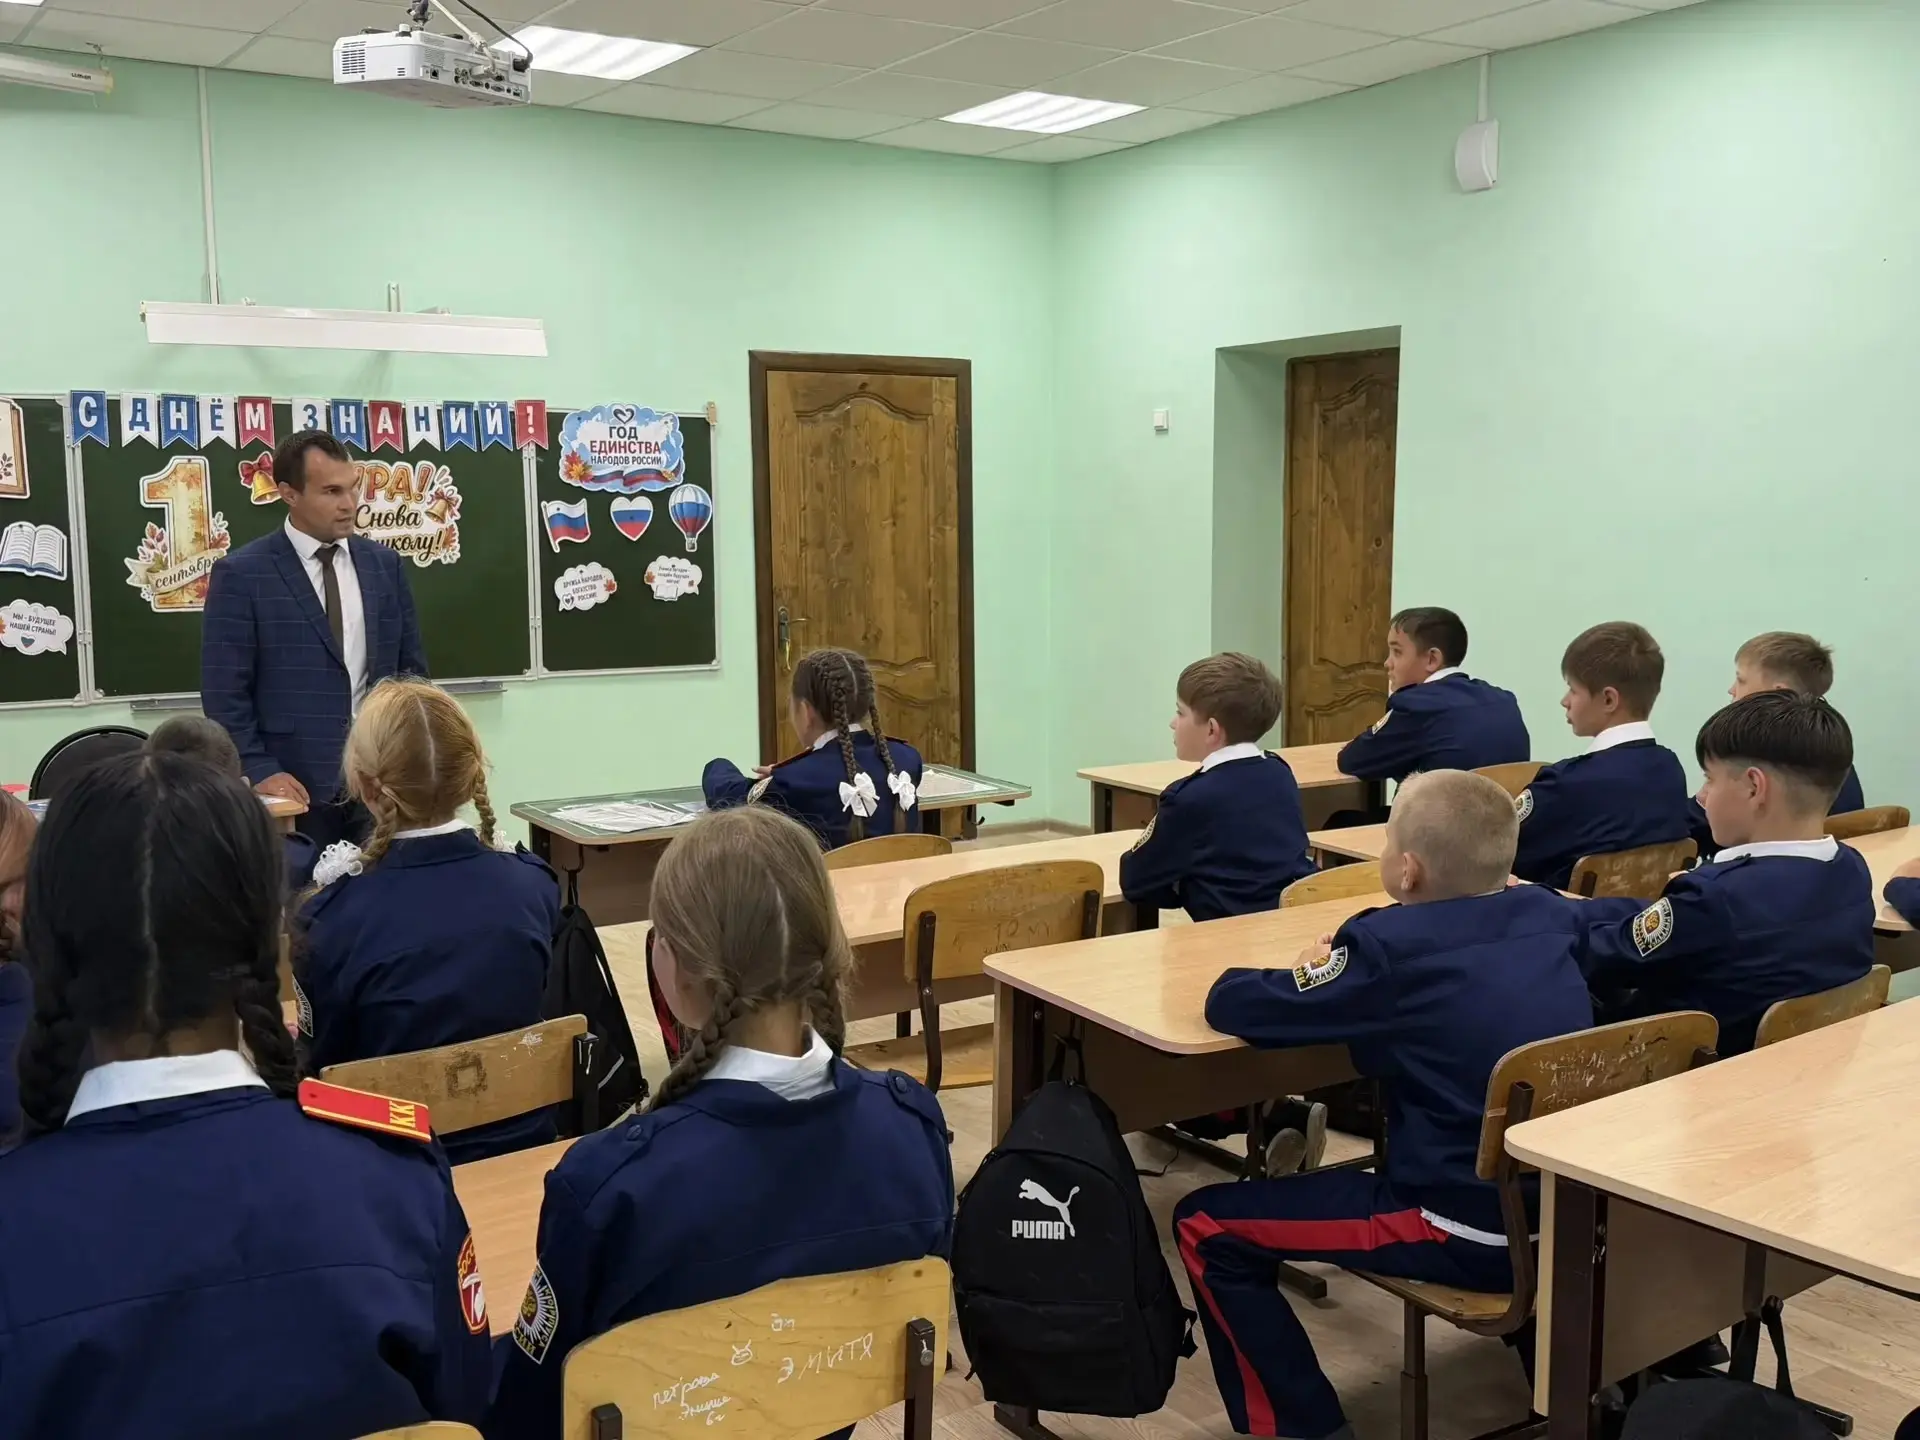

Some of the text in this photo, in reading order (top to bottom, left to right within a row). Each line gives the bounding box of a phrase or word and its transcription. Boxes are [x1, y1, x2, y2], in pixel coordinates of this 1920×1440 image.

[128, 398, 266, 431] ДНЁМ
[608, 426, 639, 440] ГОД
[590, 440, 662, 455] ЕДИНСТВА
[590, 456, 662, 466] НАРОДОВ РОССИИ
[354, 504, 421, 530] Снова
[9, 622, 31, 631] НАШЕЙ
[28, 615, 56, 626] БУДУЩЕЕ
[1011, 1219, 1065, 1240] PUMA
